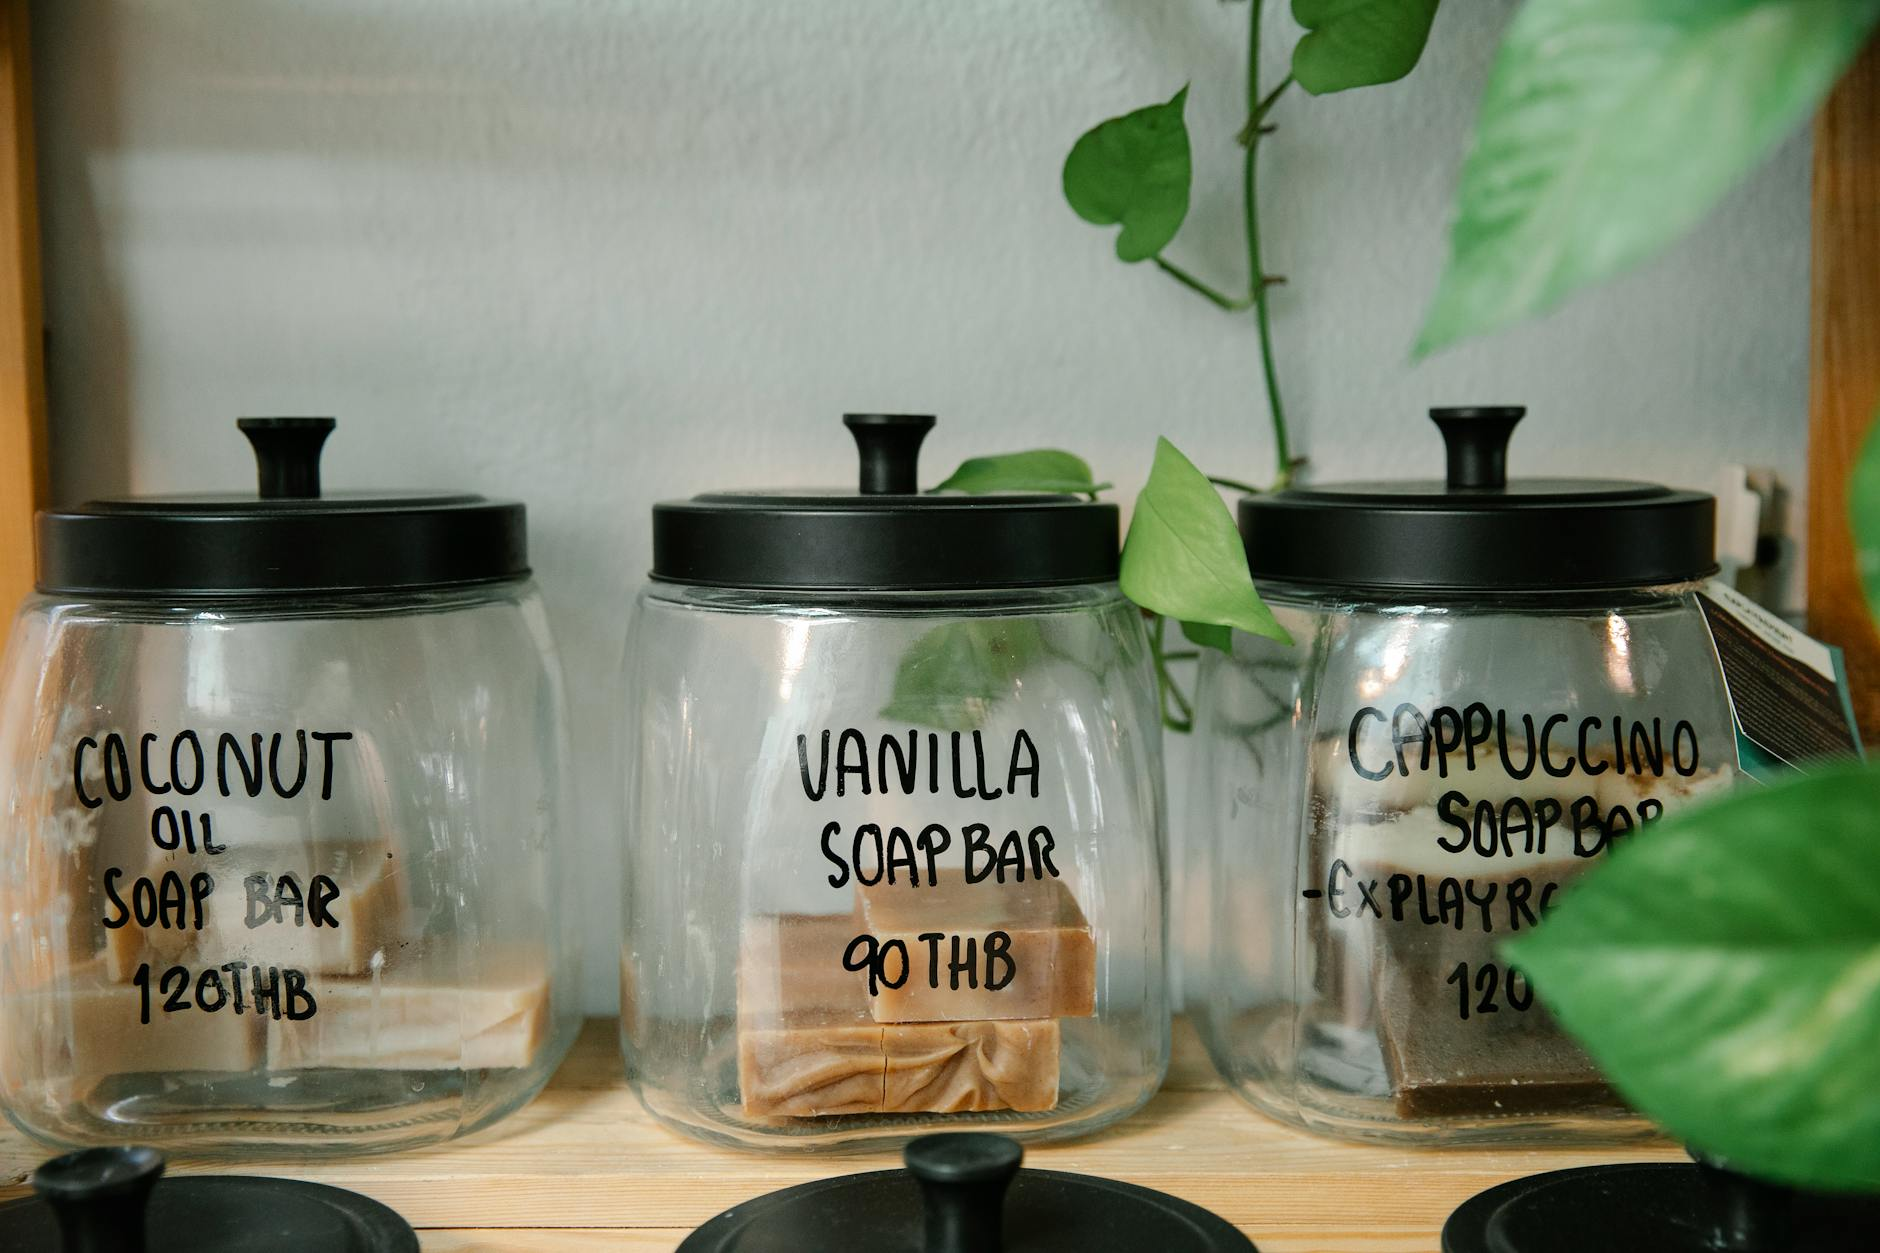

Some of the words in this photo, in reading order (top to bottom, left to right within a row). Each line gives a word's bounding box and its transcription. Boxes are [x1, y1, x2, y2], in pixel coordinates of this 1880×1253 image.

[74, 730, 352, 808] COCONUT
[797, 728, 1039, 801] VANILLA
[1348, 702, 1699, 781] CAPPUCCINO
[151, 806, 227, 855] OIL
[102, 867, 215, 930] SOAP
[243, 871, 340, 929] BAR
[1447, 962, 1534, 1020] 120
